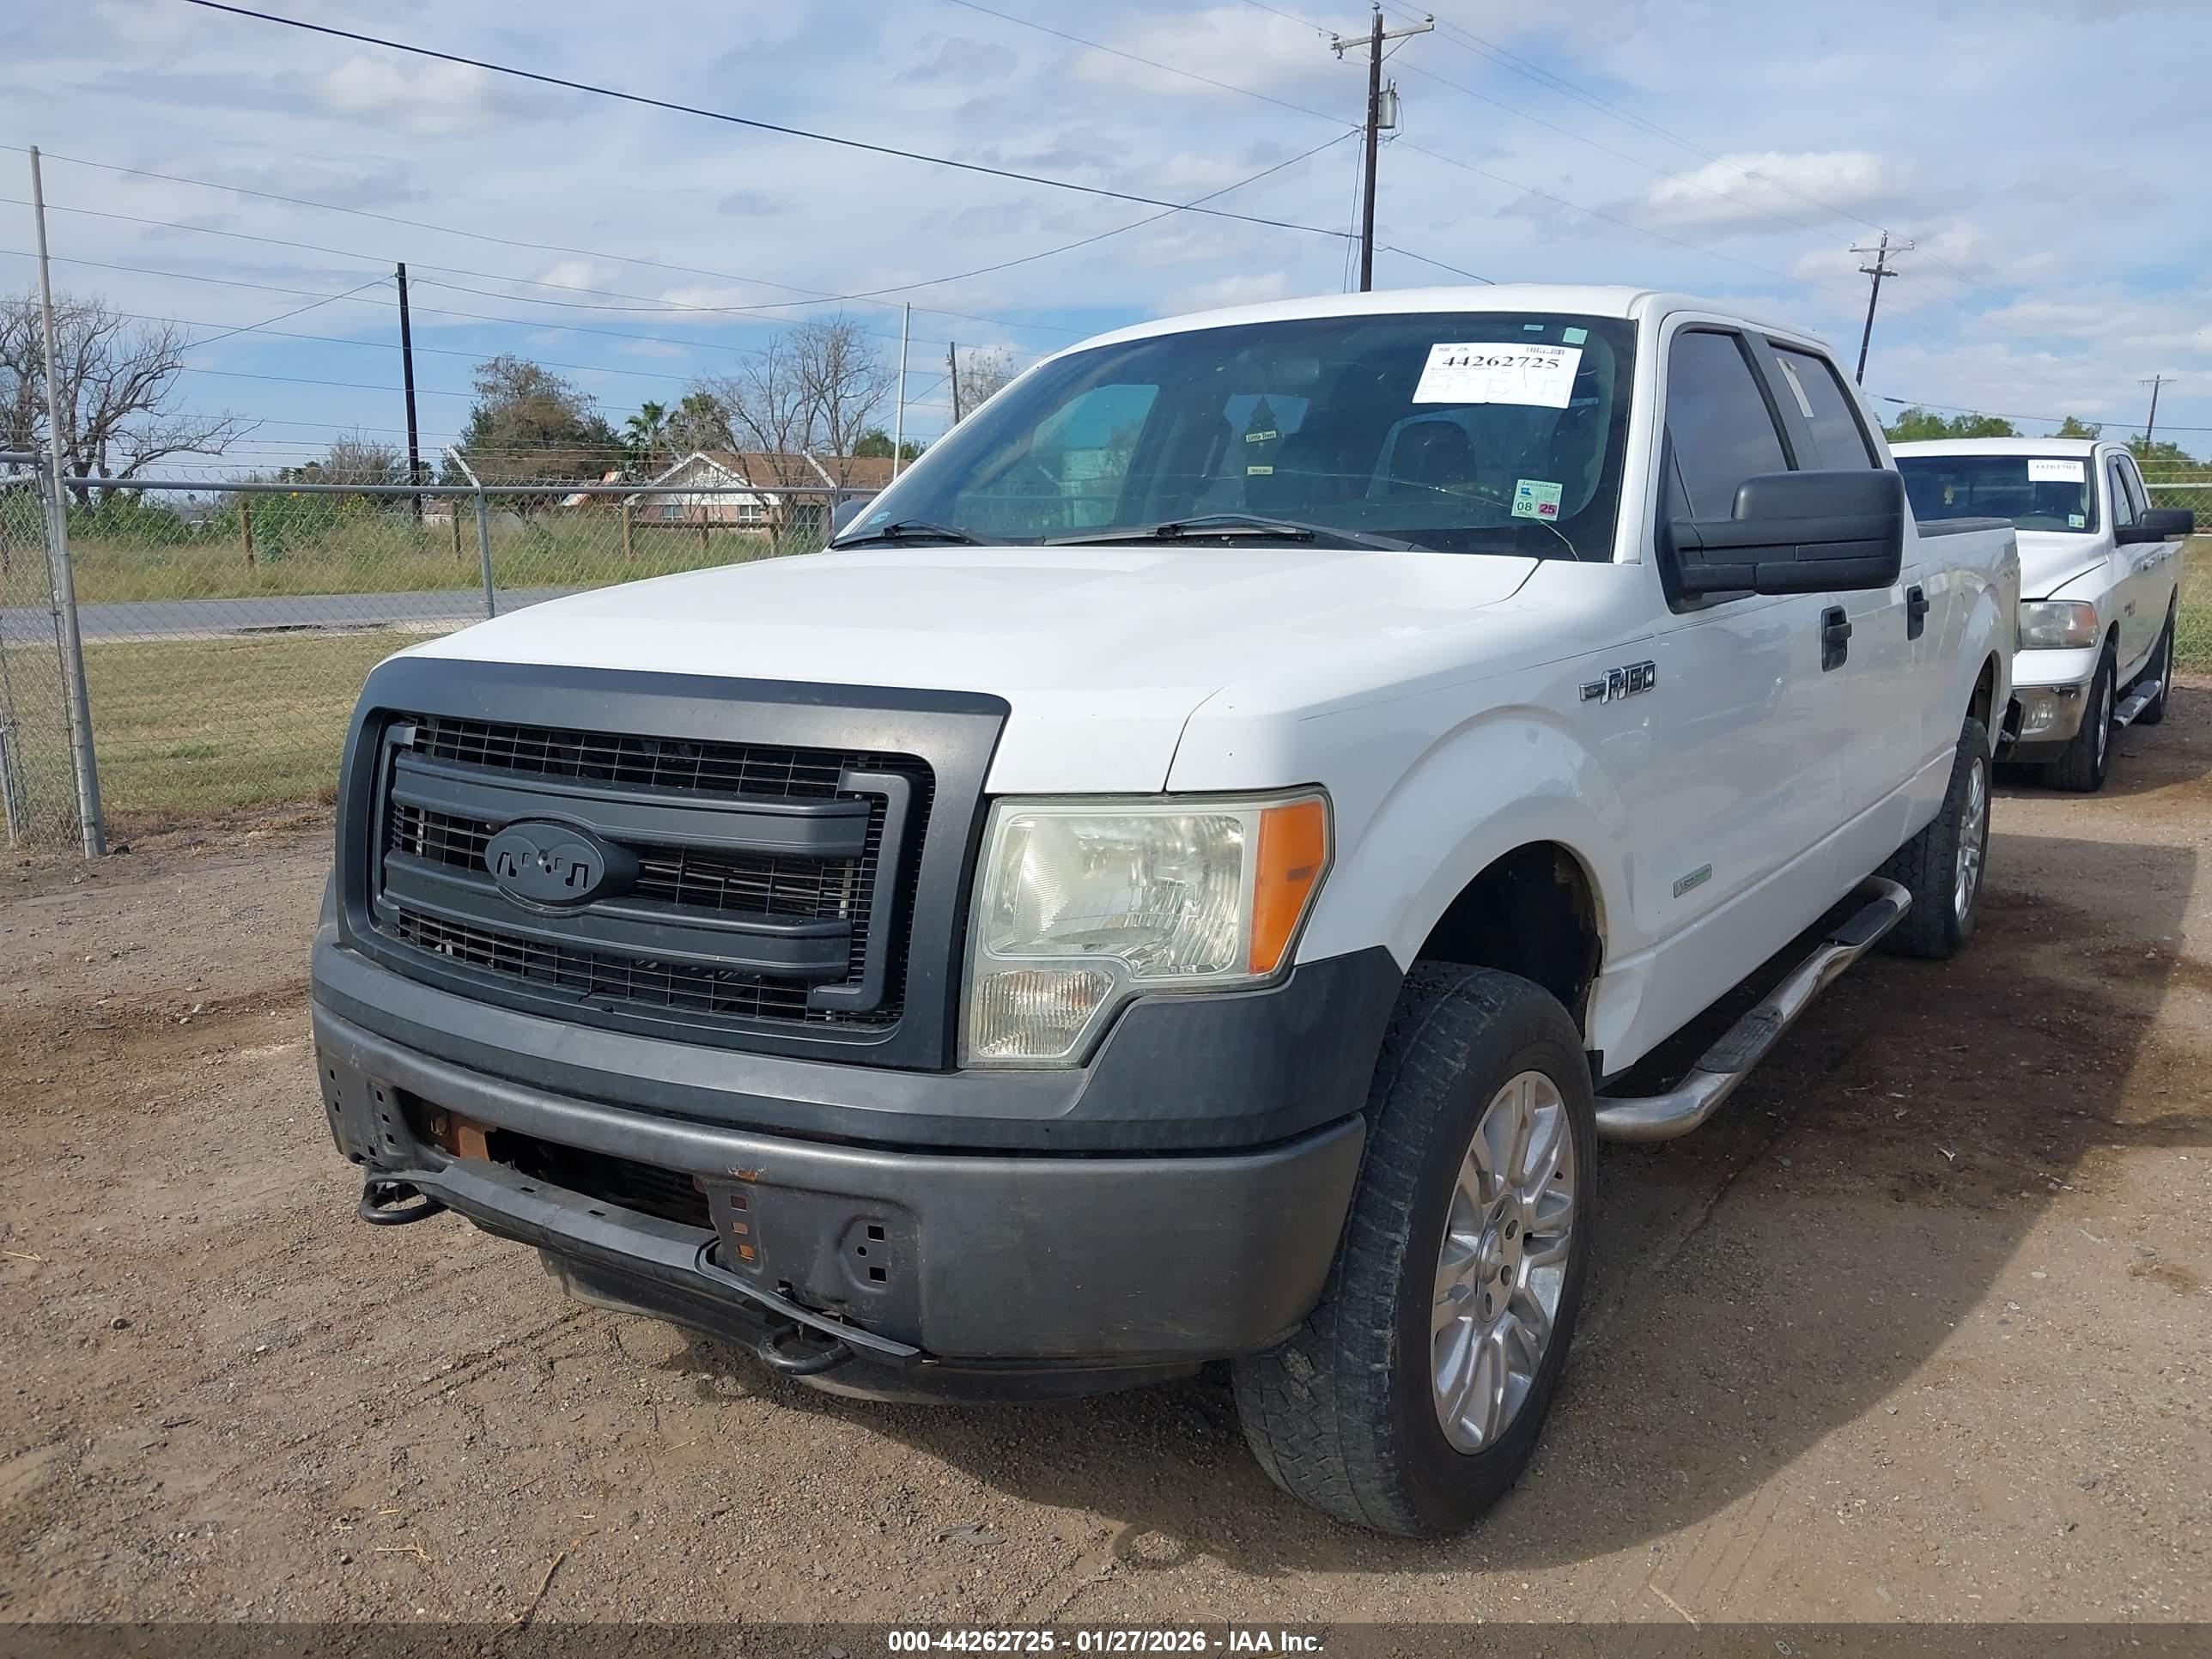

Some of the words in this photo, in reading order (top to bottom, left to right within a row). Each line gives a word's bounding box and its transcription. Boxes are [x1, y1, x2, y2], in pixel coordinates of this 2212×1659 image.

[1443, 356, 1560, 369] 44262725
[1517, 501, 1532, 512] 08
[1540, 504, 1555, 514] 25
